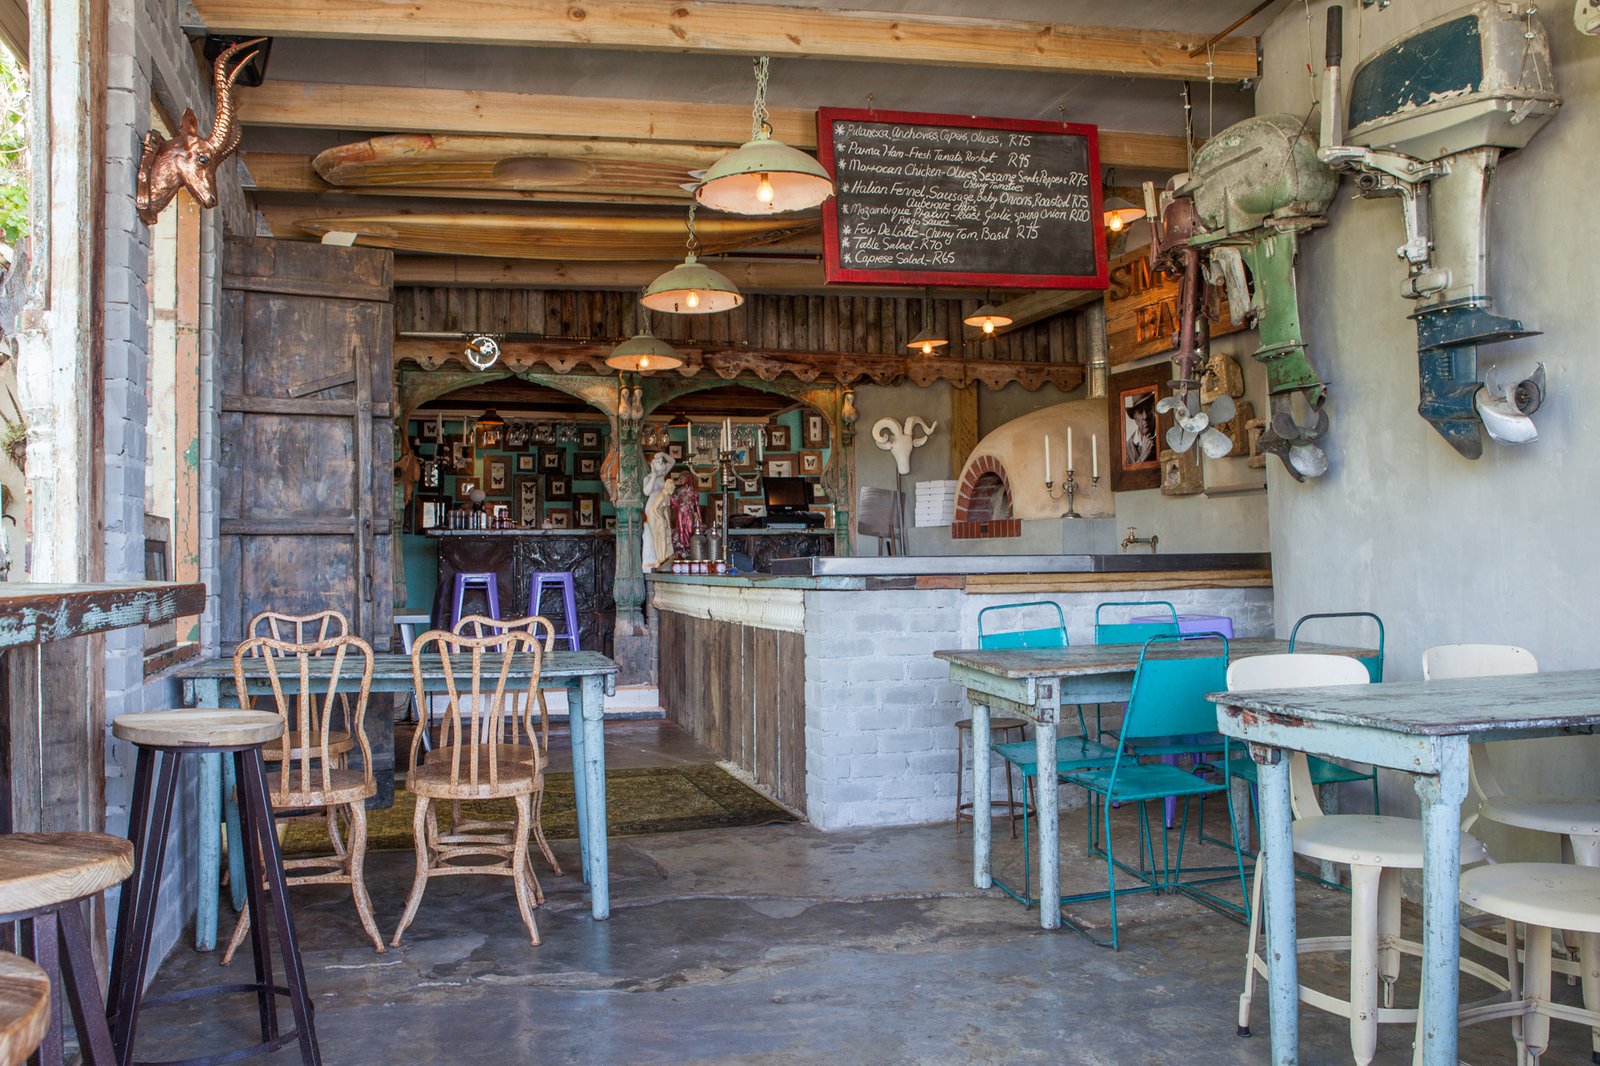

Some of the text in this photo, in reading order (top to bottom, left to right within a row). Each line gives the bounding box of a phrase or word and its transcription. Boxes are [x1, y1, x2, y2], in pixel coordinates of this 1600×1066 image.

[1009, 133, 1033, 147] R75
[848, 141, 880, 156] Parma
[965, 150, 998, 163] Rocket
[1007, 152, 1031, 168] R95
[978, 166, 1017, 182] Sesame
[1039, 169, 1068, 188] Peppers
[1068, 171, 1088, 187] R75
[851, 180, 888, 194] Italian
[1034, 192, 1070, 207] Roasted
[1071, 195, 1088, 208] R75
[850, 203, 912, 222] Mozambique
[981, 226, 1011, 240] Basil
[1016, 225, 1041, 239] R75
[853, 236, 881, 250] Table
[855, 249, 893, 267] Caprese
